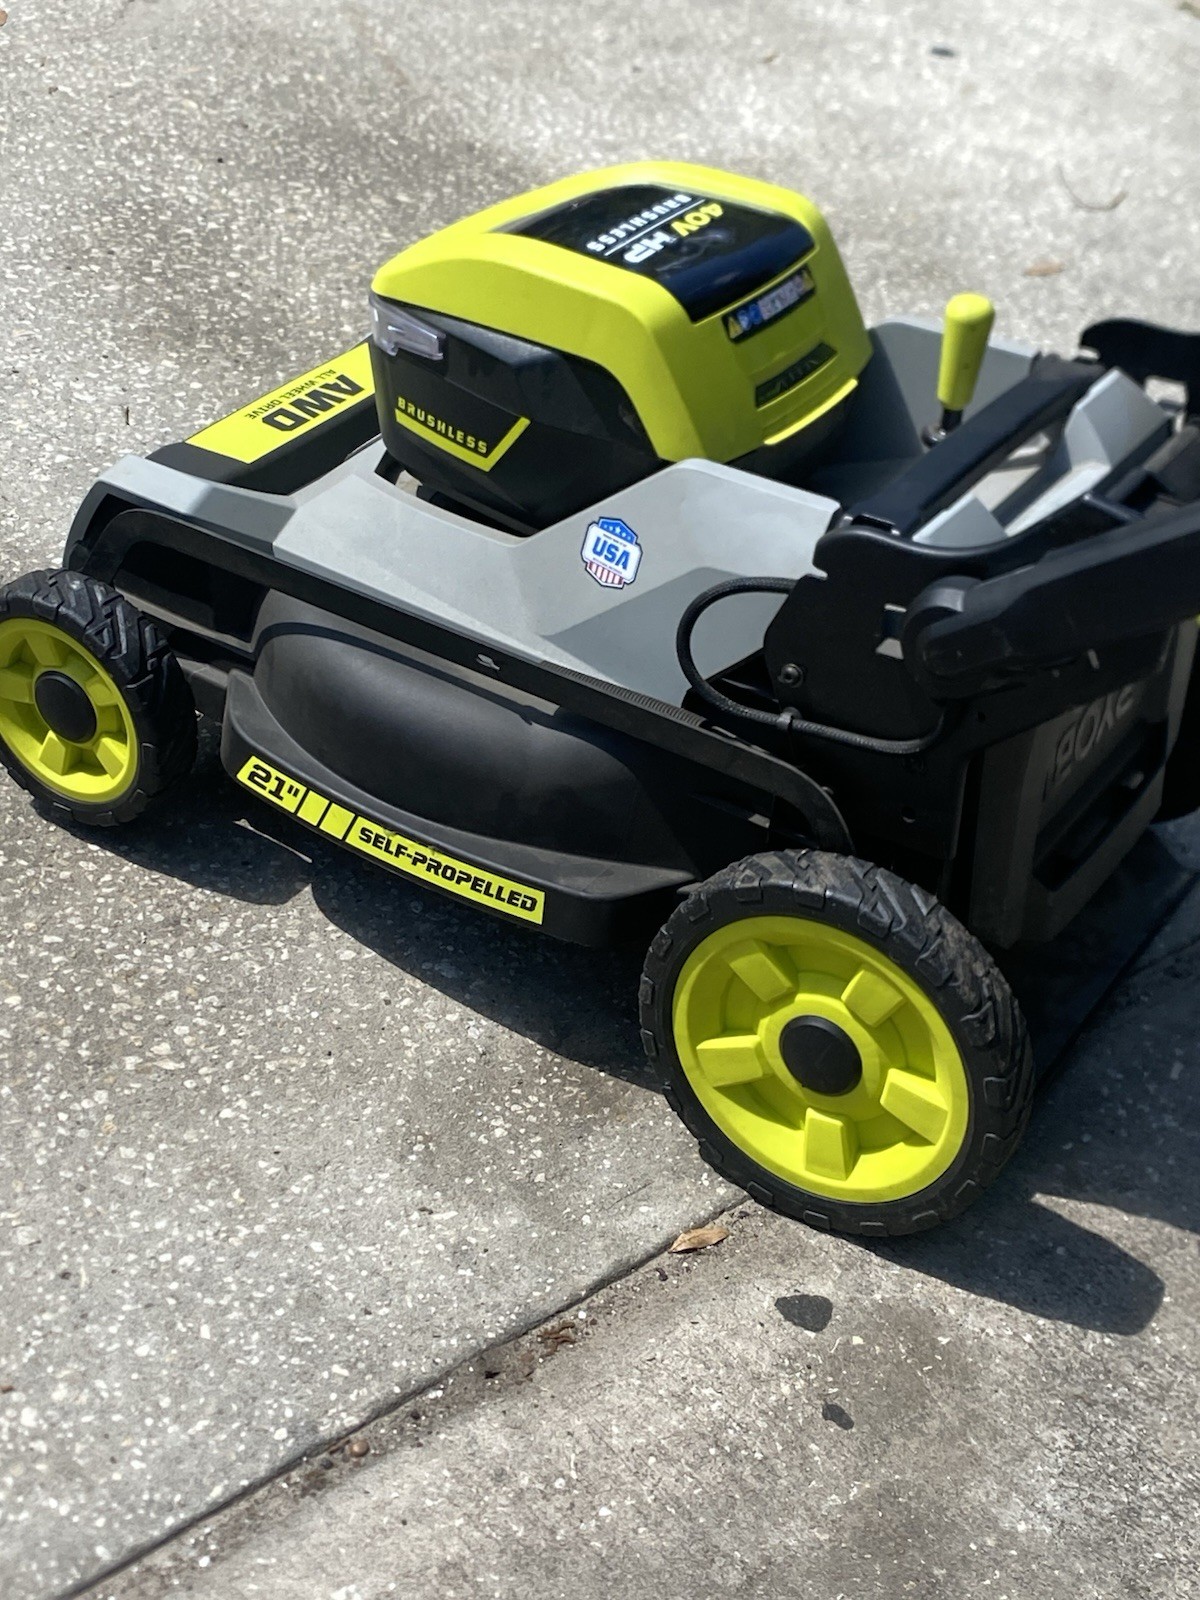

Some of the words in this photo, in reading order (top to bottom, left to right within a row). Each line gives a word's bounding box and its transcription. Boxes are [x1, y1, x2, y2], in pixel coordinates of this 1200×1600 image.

[586, 193, 692, 253] BRUSHLESS
[671, 202, 724, 237] 40V
[623, 231, 671, 263] HP
[279, 379, 316, 400] WHEEL
[315, 369, 337, 382] ALL
[243, 399, 283, 420] DRIVE
[262, 373, 365, 432] AWD
[397, 396, 489, 455] BRUSHLESS
[592, 536, 631, 571] USA
[247, 763, 301, 801] 21"
[358, 827, 539, 913] SELF-PROPELLED
